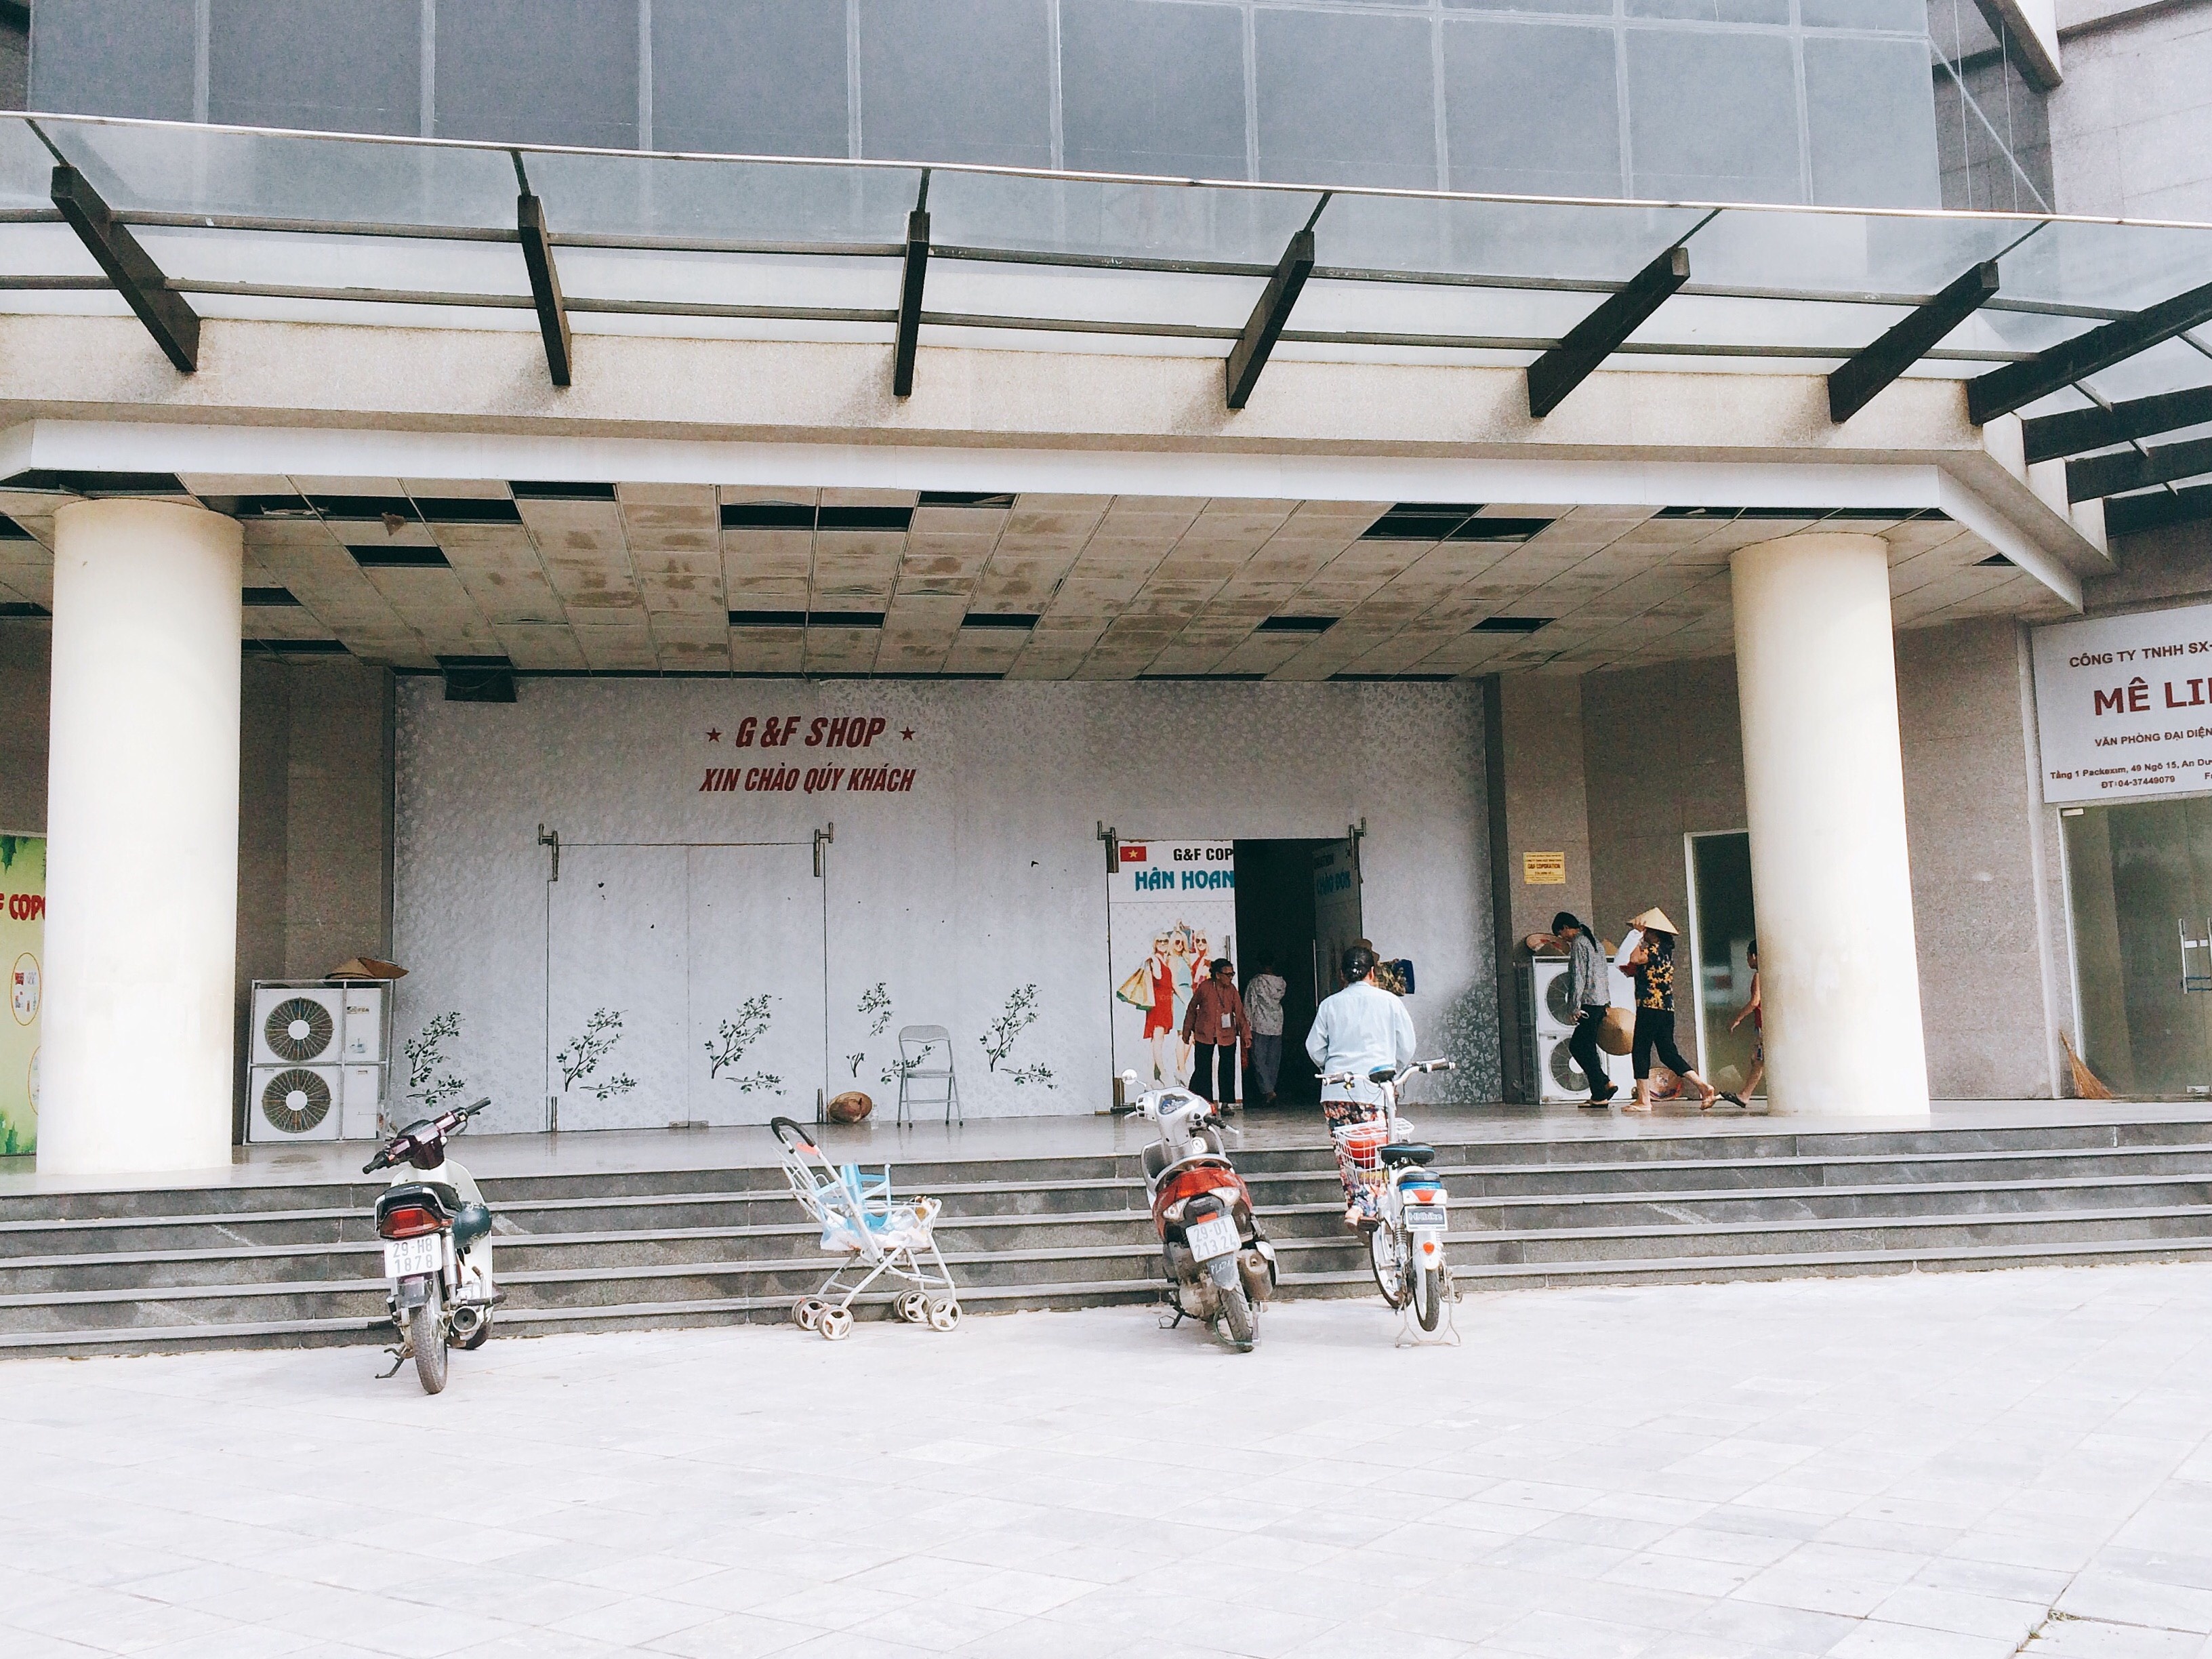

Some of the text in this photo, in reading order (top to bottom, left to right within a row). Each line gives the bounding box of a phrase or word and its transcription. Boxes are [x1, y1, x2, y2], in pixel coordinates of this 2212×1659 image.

[2069, 652, 2113, 668] CÔNG
[2116, 649, 2136, 662] TY
[2142, 644, 2184, 659] TNHH
[2093, 676, 2150, 716] MÊ
[804, 716, 886, 747] SHOP
[2095, 736, 2118, 747] VĂN
[2165, 731, 2184, 741] ĐẠI
[2187, 726, 2212, 739] DIỆN
[2182, 760, 2194, 768] An
[699, 768, 741, 792] XIN
[744, 762, 800, 792] CHÀO
[846, 763, 916, 792] KHÁCH
[1173, 848, 1233, 861] G&F COP
[1134, 866, 1174, 891] HÂN
[1181, 870, 1235, 890] HOAN
[394, 1254, 433, 1273] 1878
